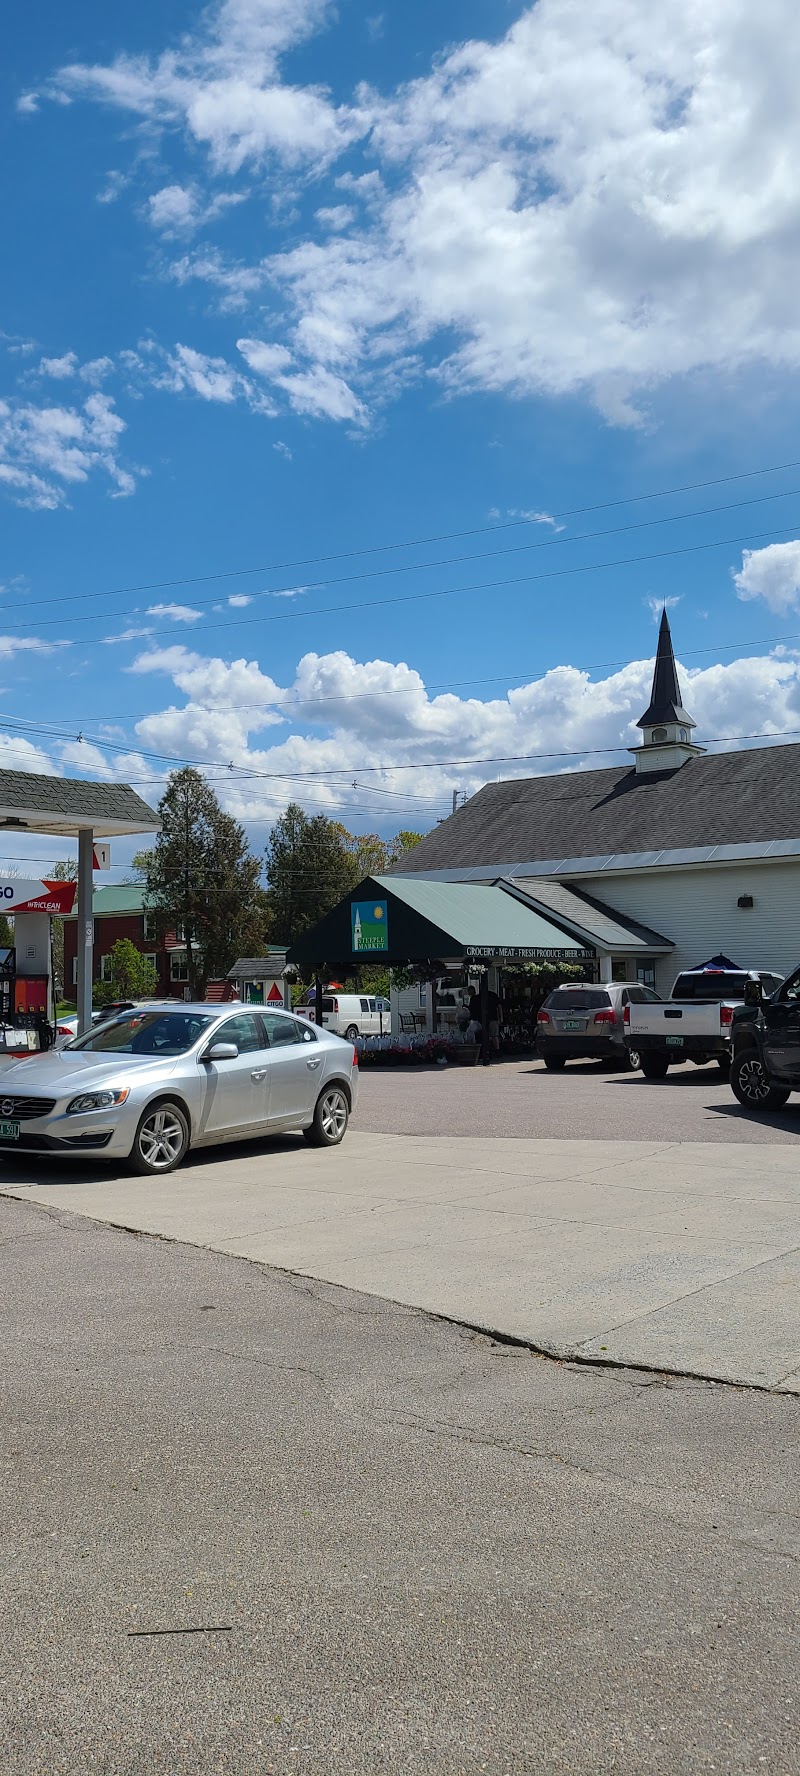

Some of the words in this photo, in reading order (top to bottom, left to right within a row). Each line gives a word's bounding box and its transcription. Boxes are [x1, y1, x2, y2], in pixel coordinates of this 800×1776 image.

[102, 850, 106, 862] 1
[466, 946, 495, 956] GROCERY
[499, 948, 515, 957] MEAT
[518, 948, 536, 958] FRESH
[536, 949, 561, 958] PRODUCE
[565, 950, 578, 958] BEER
[582, 950, 594, 958] WINE
